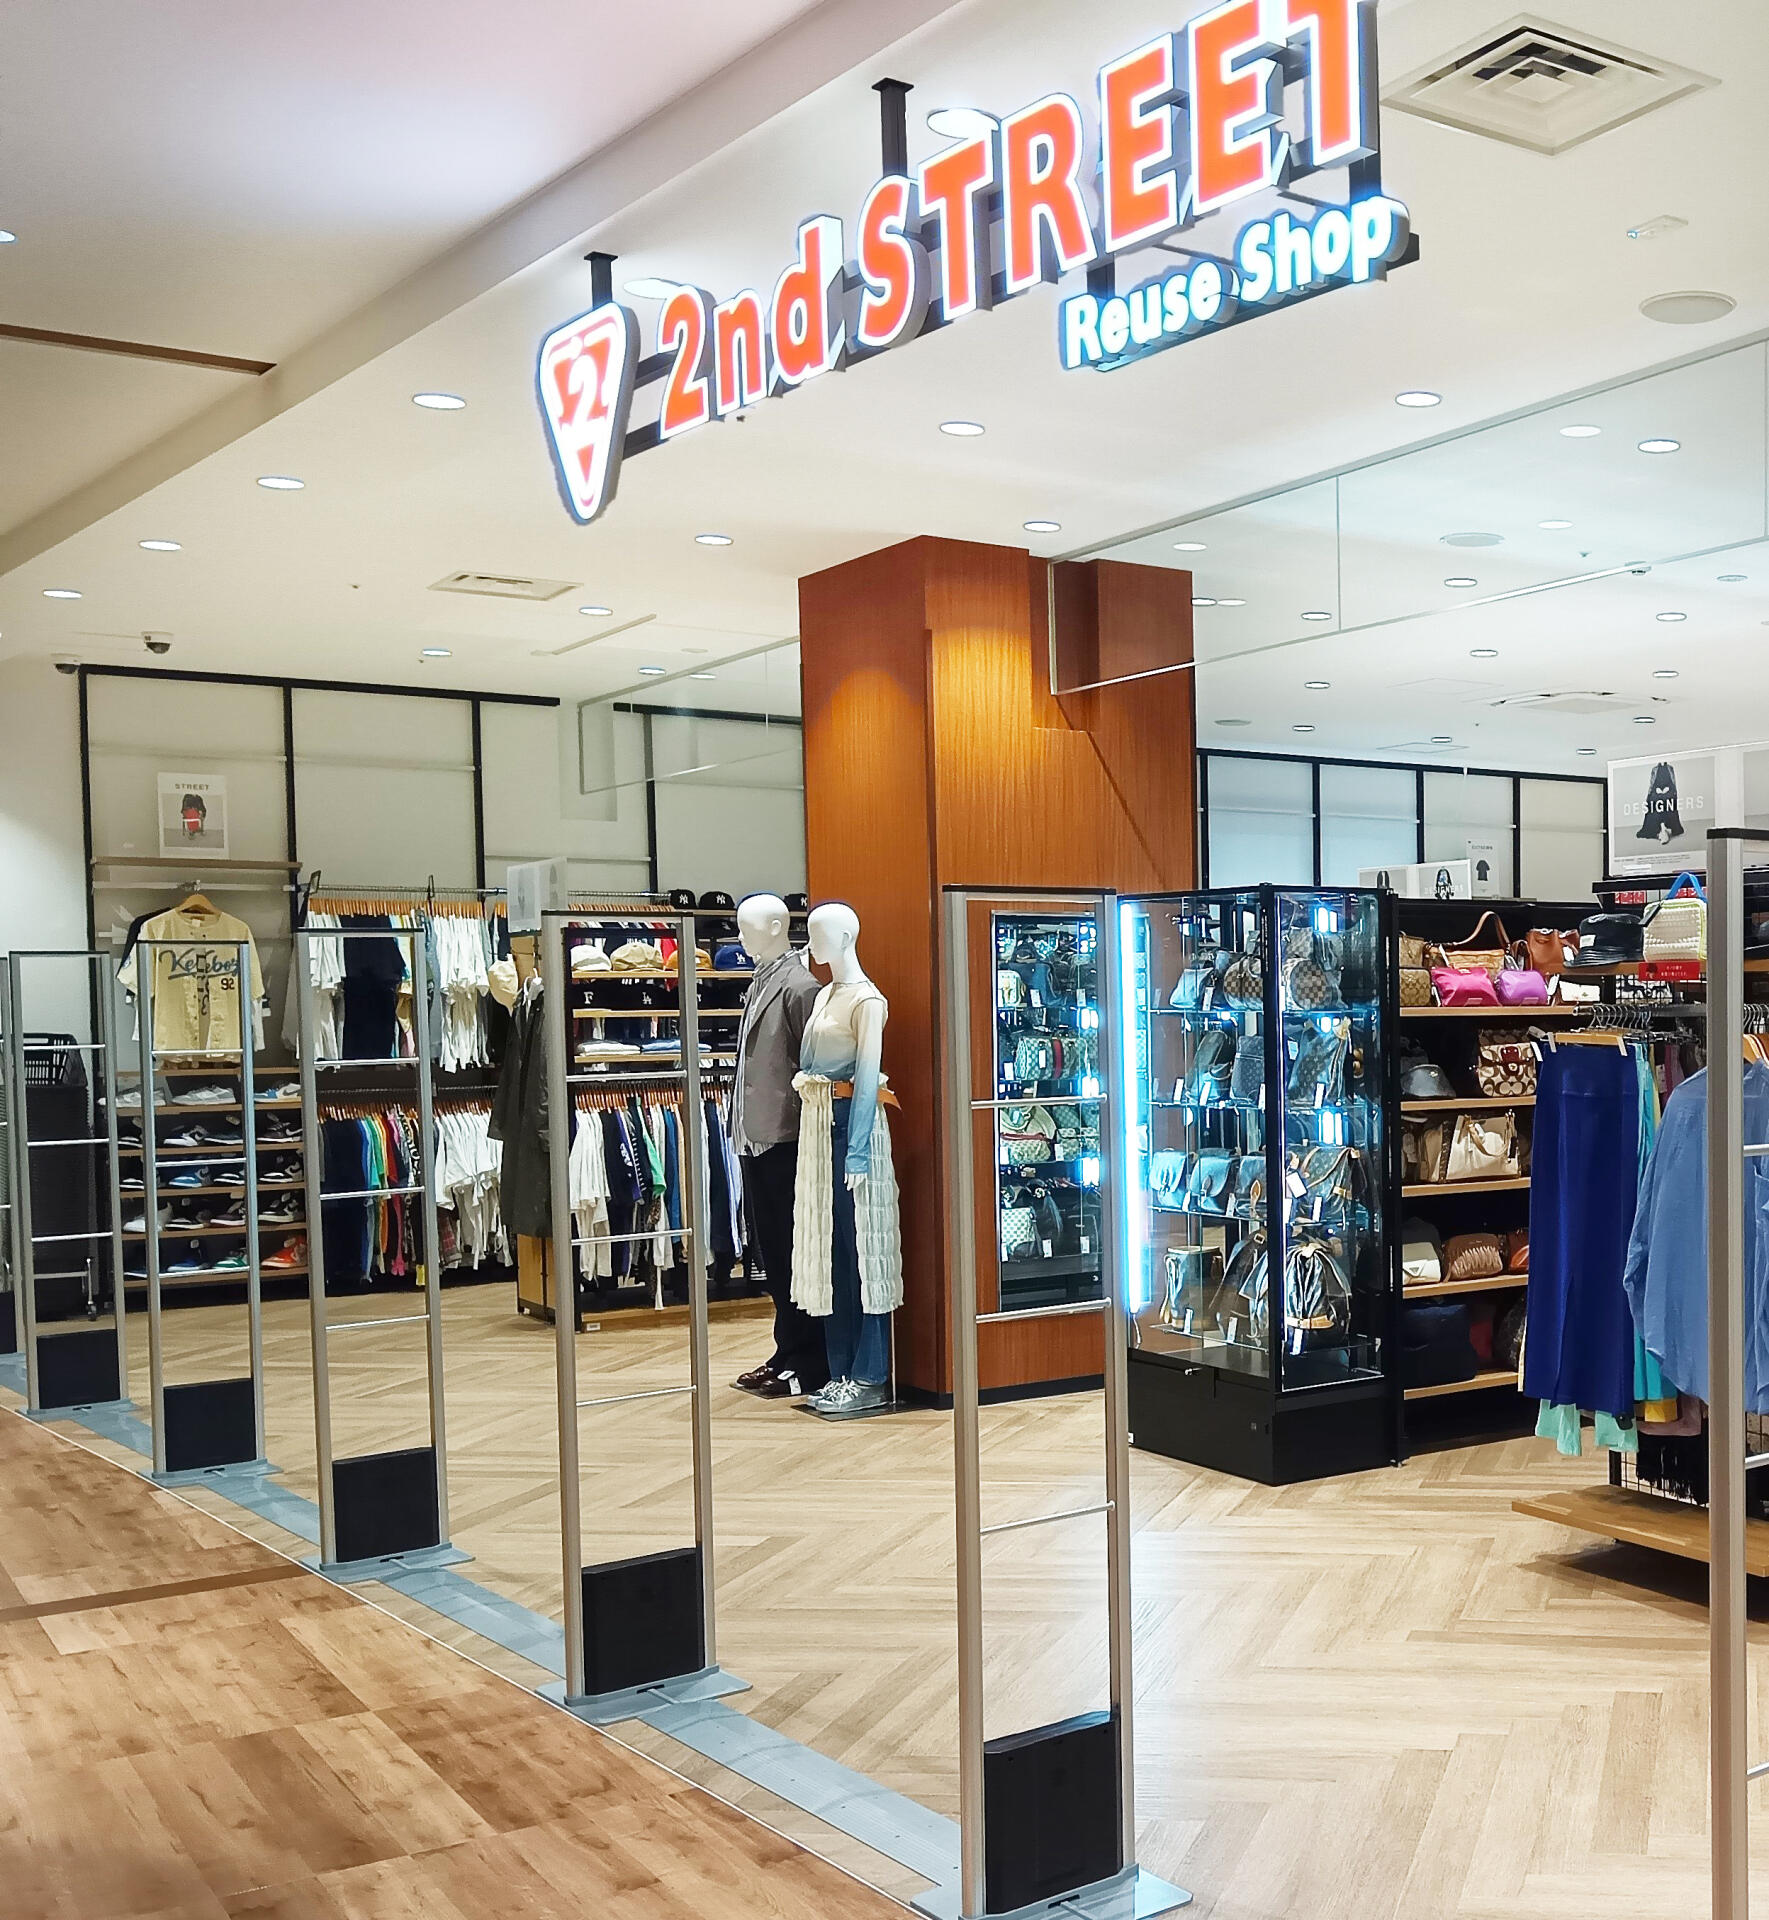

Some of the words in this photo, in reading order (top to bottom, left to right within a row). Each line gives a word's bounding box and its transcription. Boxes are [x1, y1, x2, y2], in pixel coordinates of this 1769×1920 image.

[657, 217, 830, 440] 2nd
[855, 0, 1362, 348] STREET
[1064, 260, 1222, 370] Reuse
[1240, 196, 1396, 305] Shop
[175, 783, 209, 791] STREET
[1623, 795, 1704, 816] DESIGNERS
[220, 977, 235, 991] 92
[583, 991, 594, 1005] F
